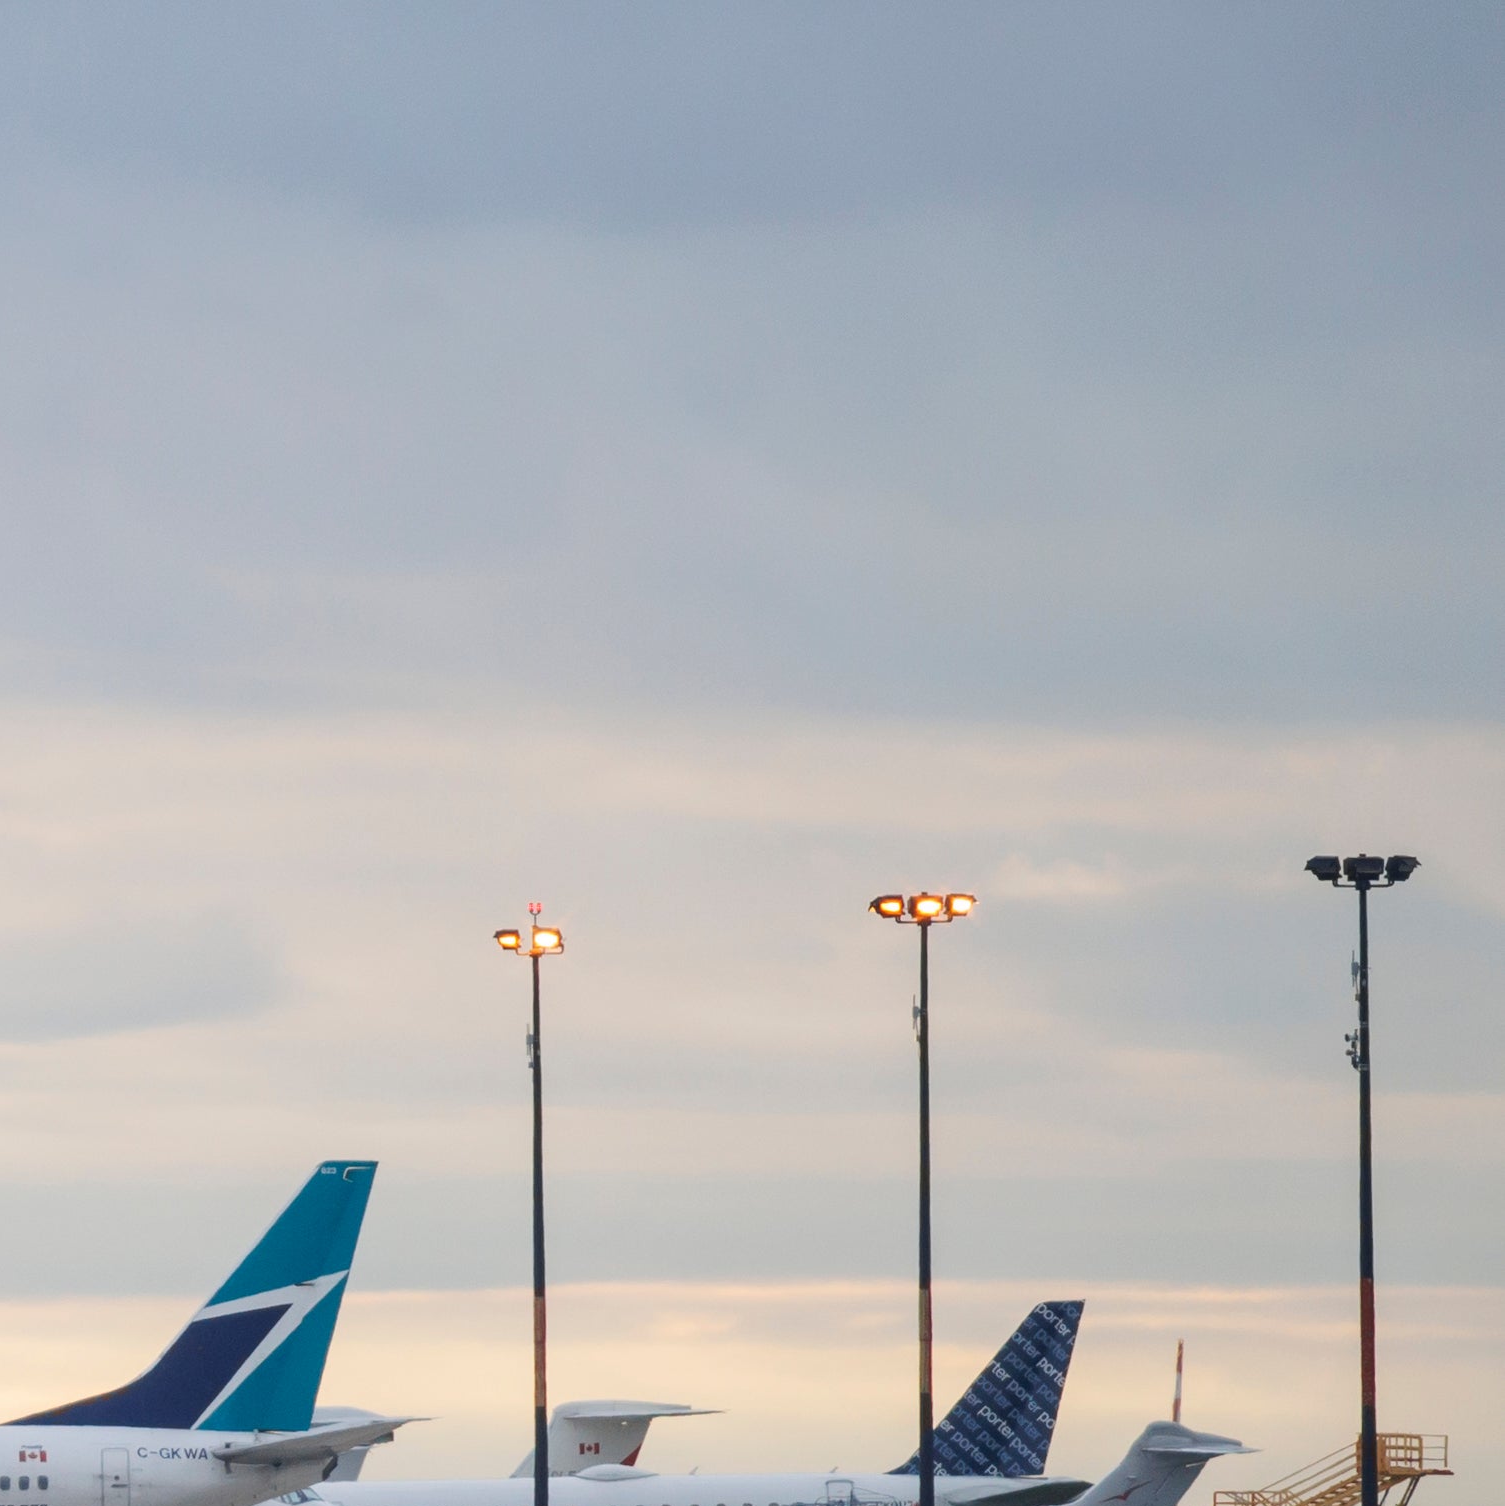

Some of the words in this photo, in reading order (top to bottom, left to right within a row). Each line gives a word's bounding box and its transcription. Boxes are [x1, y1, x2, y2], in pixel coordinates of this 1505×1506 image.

[1034, 1303, 1072, 1337] porter
[1011, 1331, 1041, 1358] orter
[1036, 1357, 1066, 1388] porte
[1005, 1378, 1042, 1413] porter
[951, 1405, 982, 1432] orter
[137, 1446, 208, 1460] C-GKWA
[950, 1430, 989, 1466] porter
[976, 1405, 1015, 1440] porter
[1009, 1437, 1045, 1471] porter
